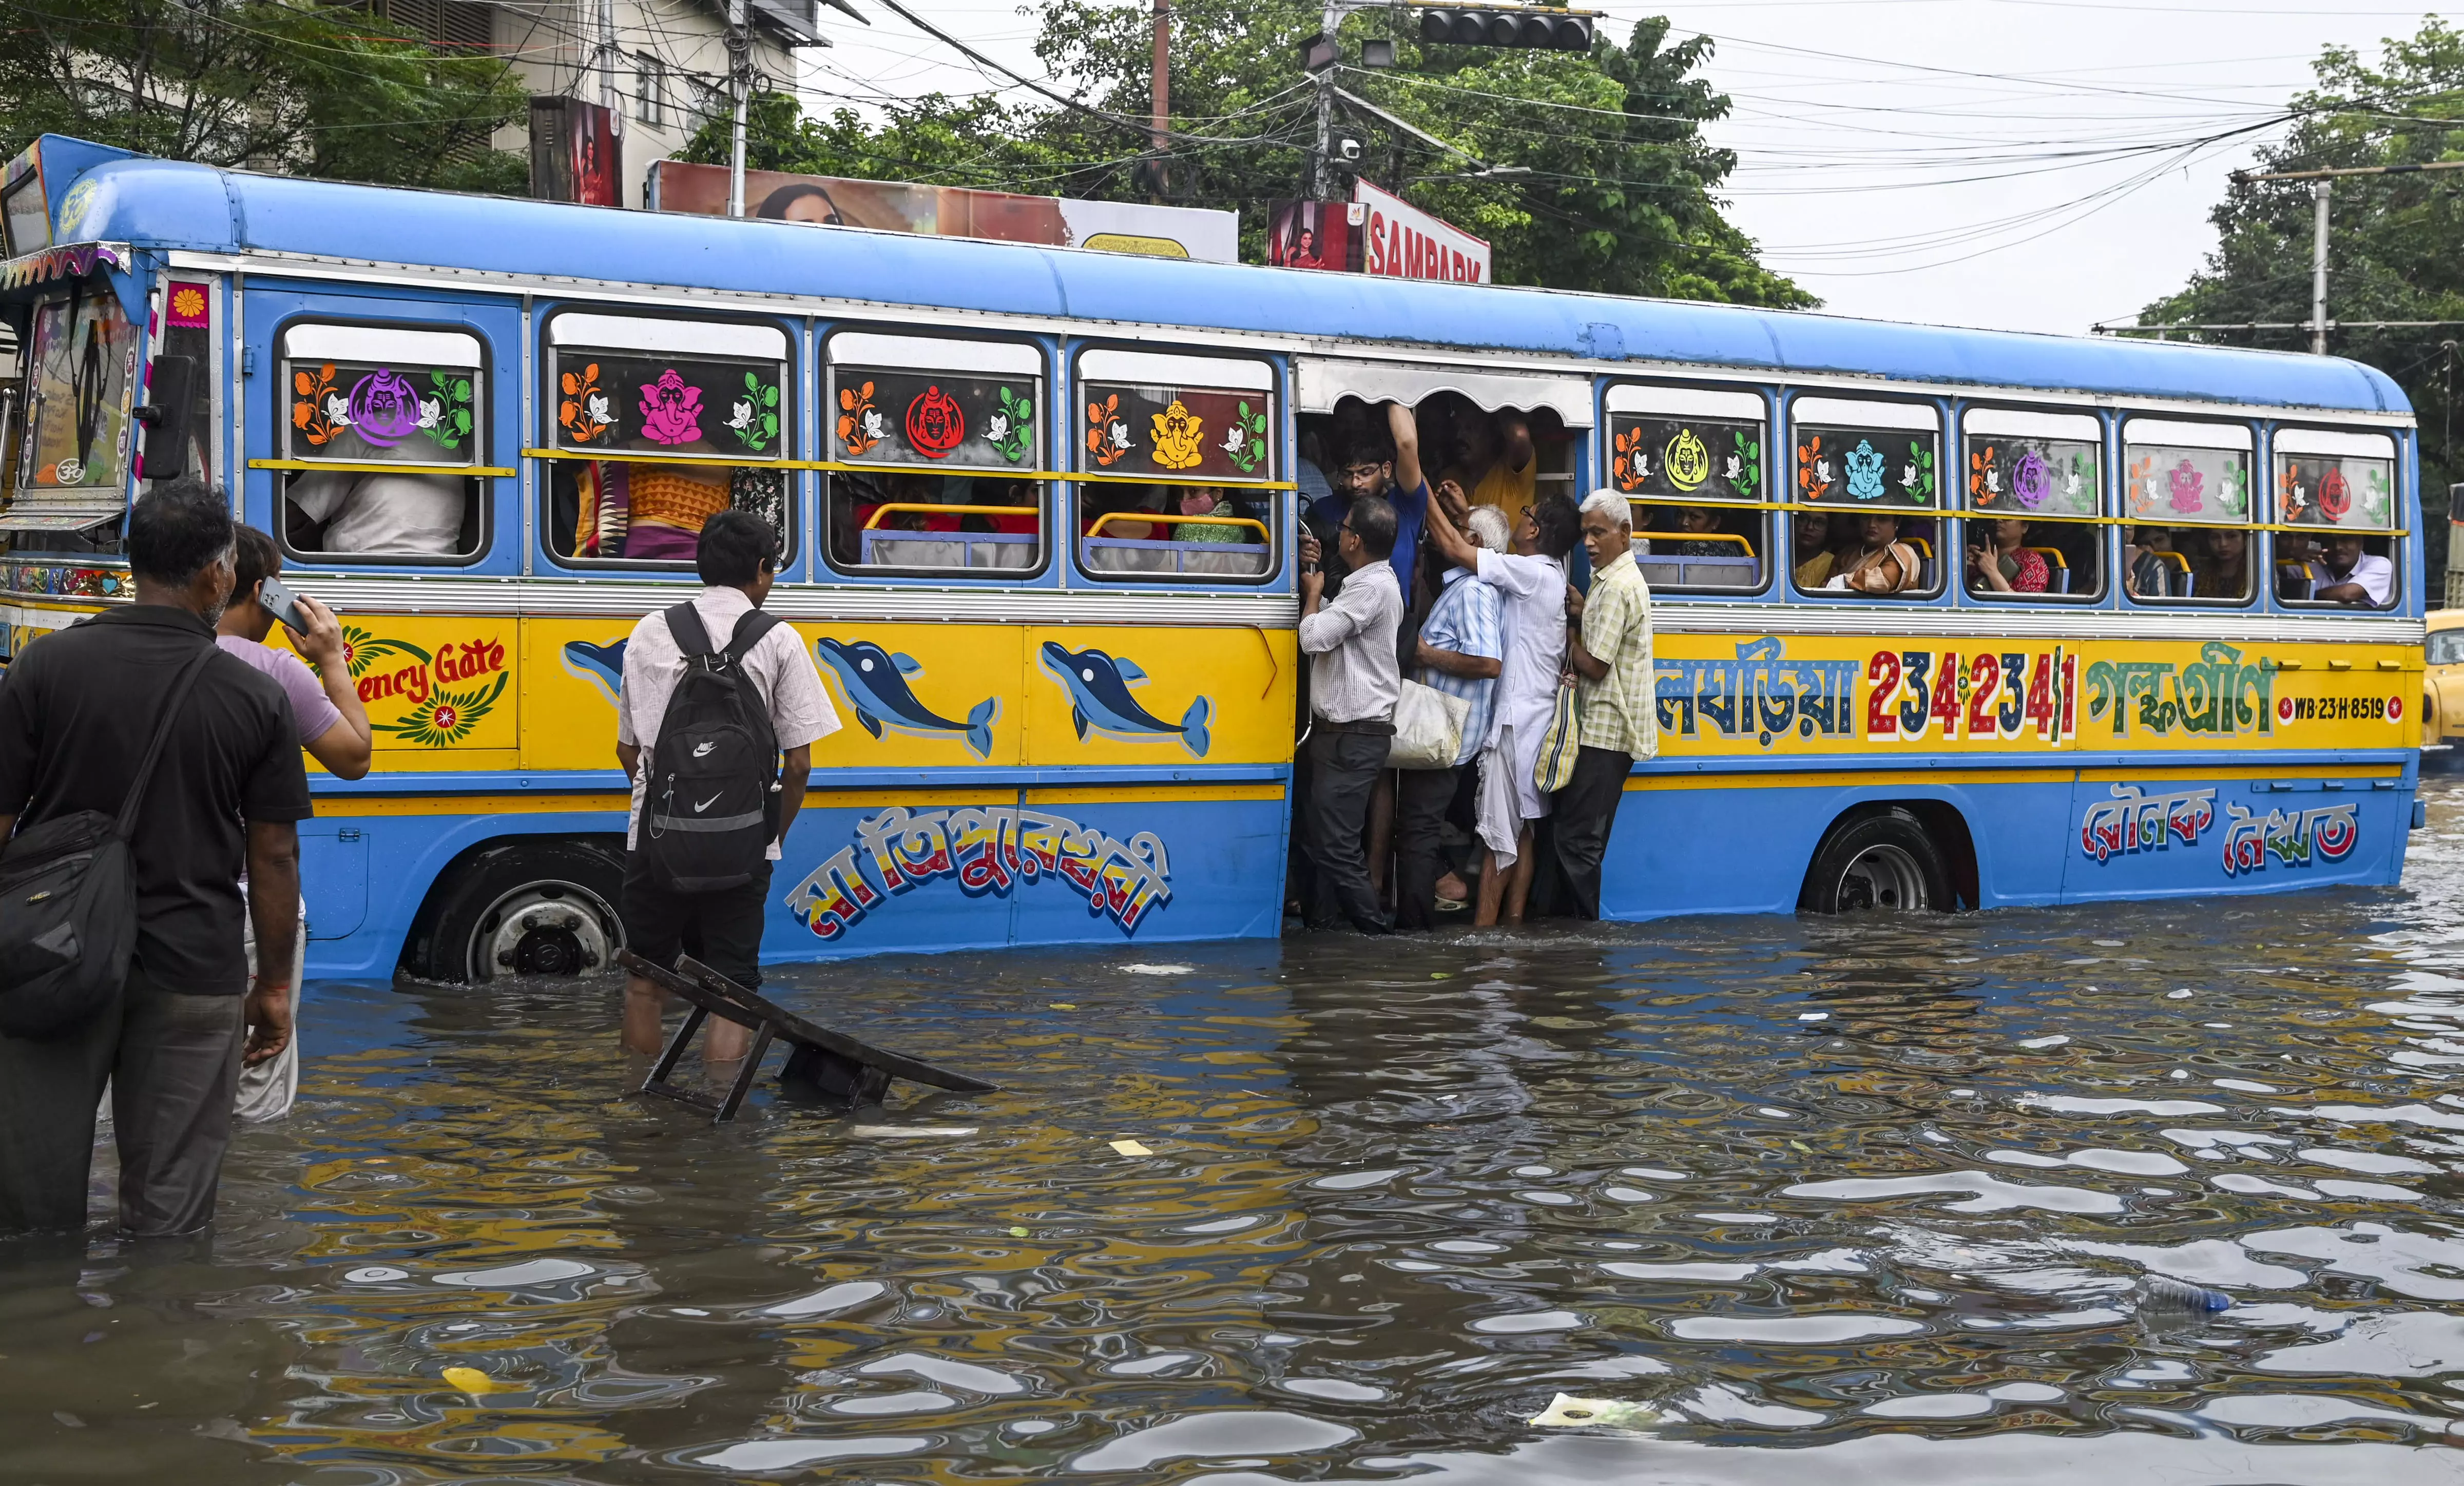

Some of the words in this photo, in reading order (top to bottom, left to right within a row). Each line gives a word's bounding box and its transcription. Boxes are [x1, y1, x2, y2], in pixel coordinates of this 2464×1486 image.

[353, 664, 429, 704] ency
[435, 631, 507, 684] Gate
[697, 741, 714, 751] NIKE
